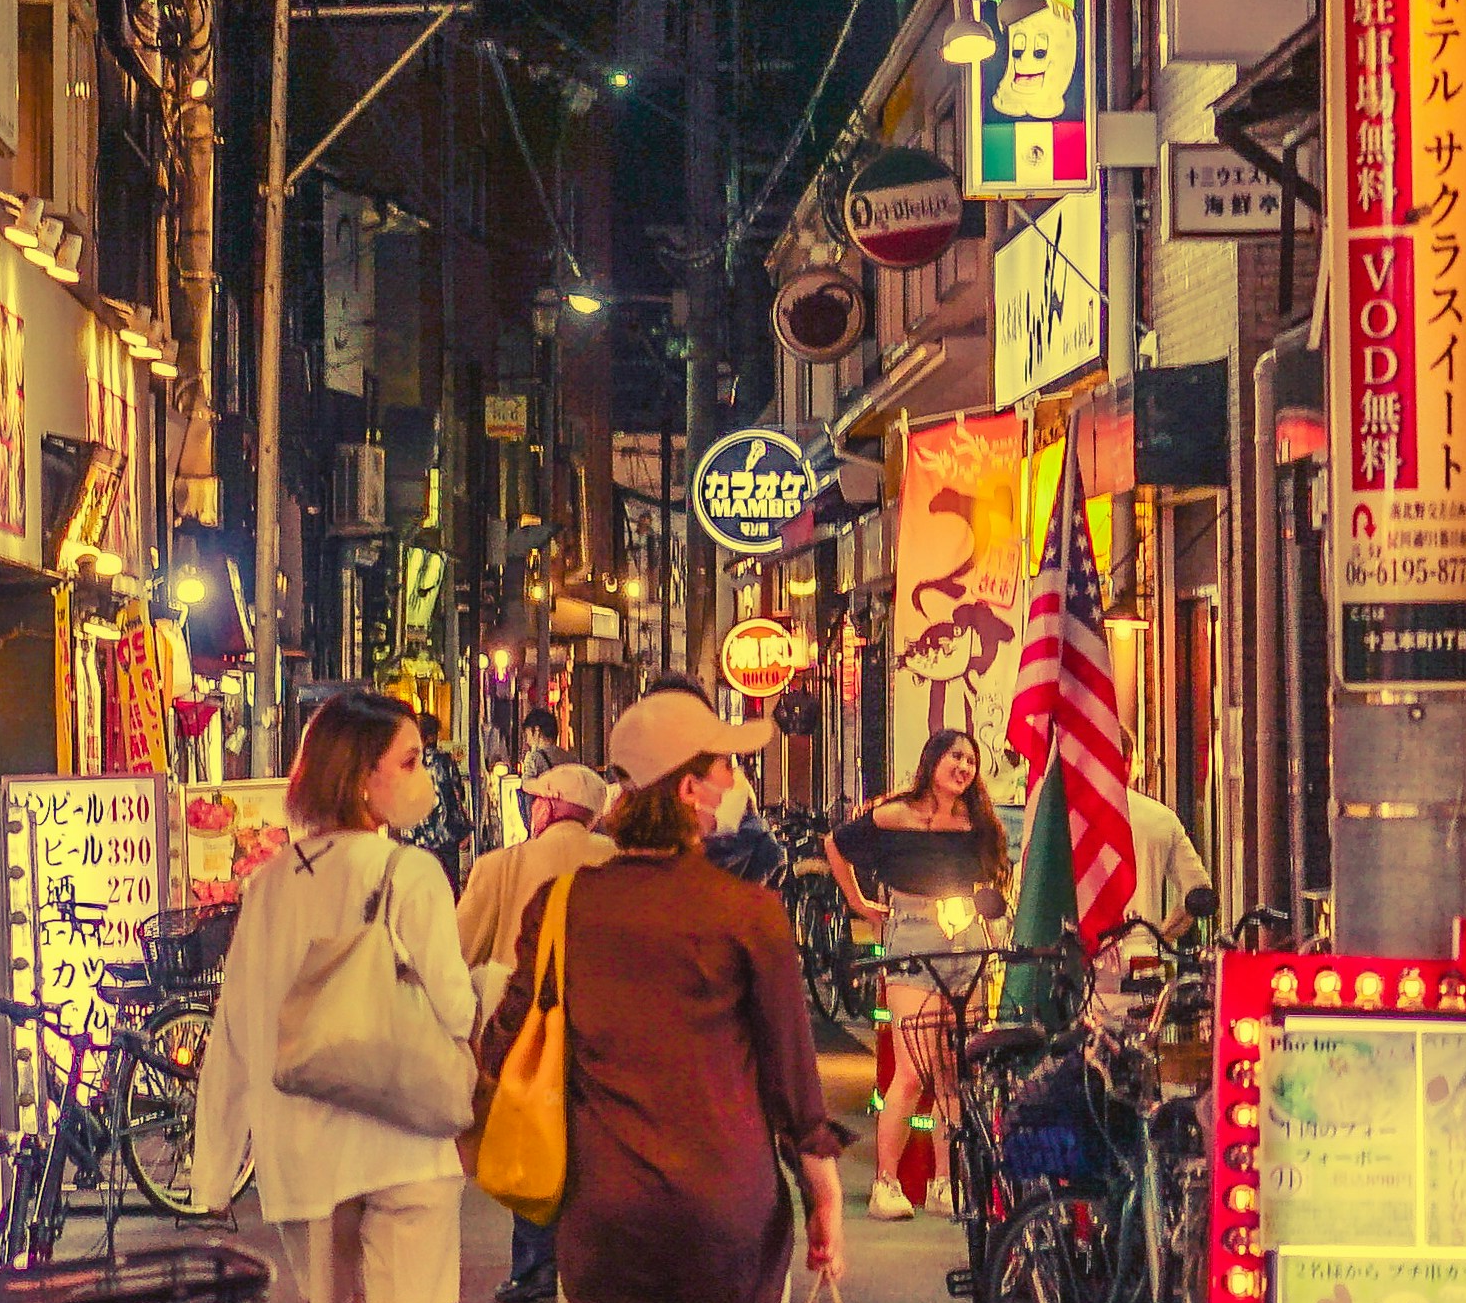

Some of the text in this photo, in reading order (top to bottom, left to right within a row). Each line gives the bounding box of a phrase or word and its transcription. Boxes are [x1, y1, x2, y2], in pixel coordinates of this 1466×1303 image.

[1358, 248, 1402, 484] VOD無料
[1423, 130, 1465, 491] サクラスイート
[107, 836, 151, 867] 390
[107, 875, 151, 904] 270
